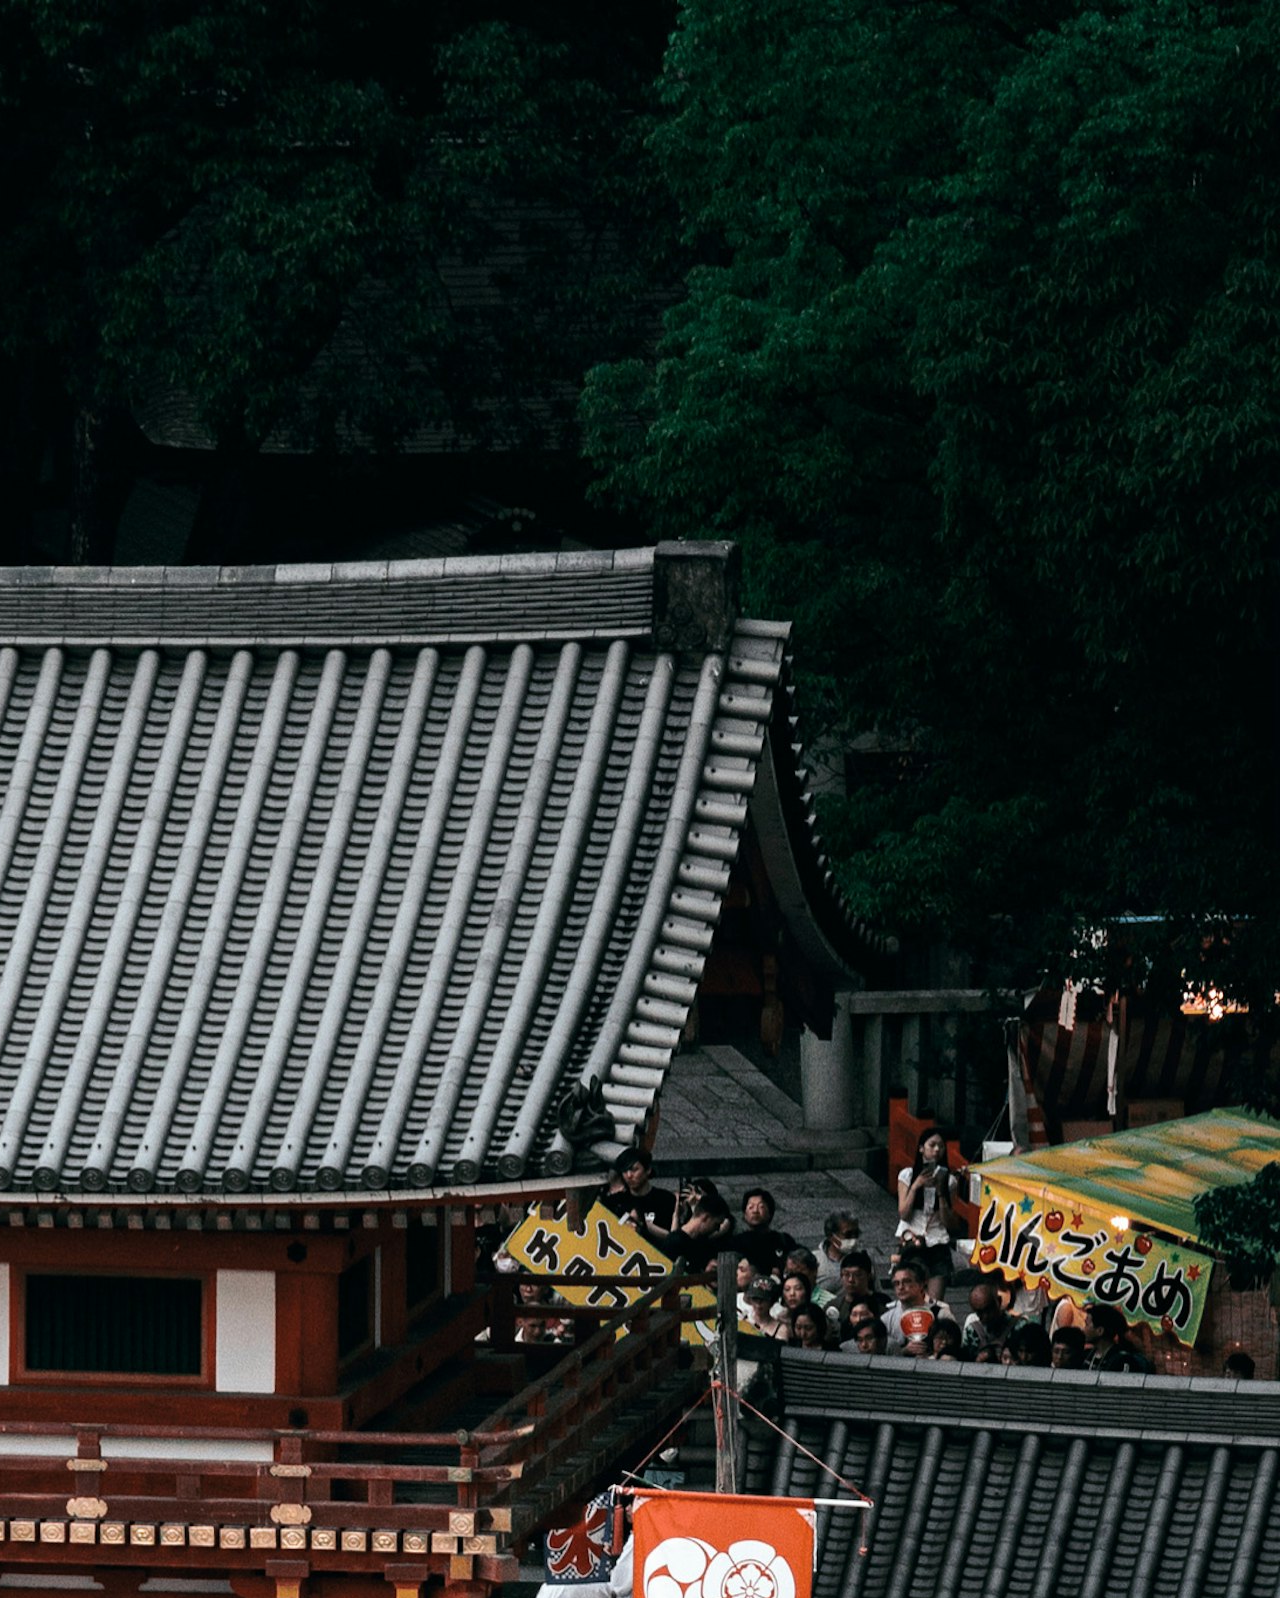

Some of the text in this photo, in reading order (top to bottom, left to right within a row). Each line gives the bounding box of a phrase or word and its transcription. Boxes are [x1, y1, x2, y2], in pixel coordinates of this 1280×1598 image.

[979, 1200, 1192, 1329] りんごあめ
